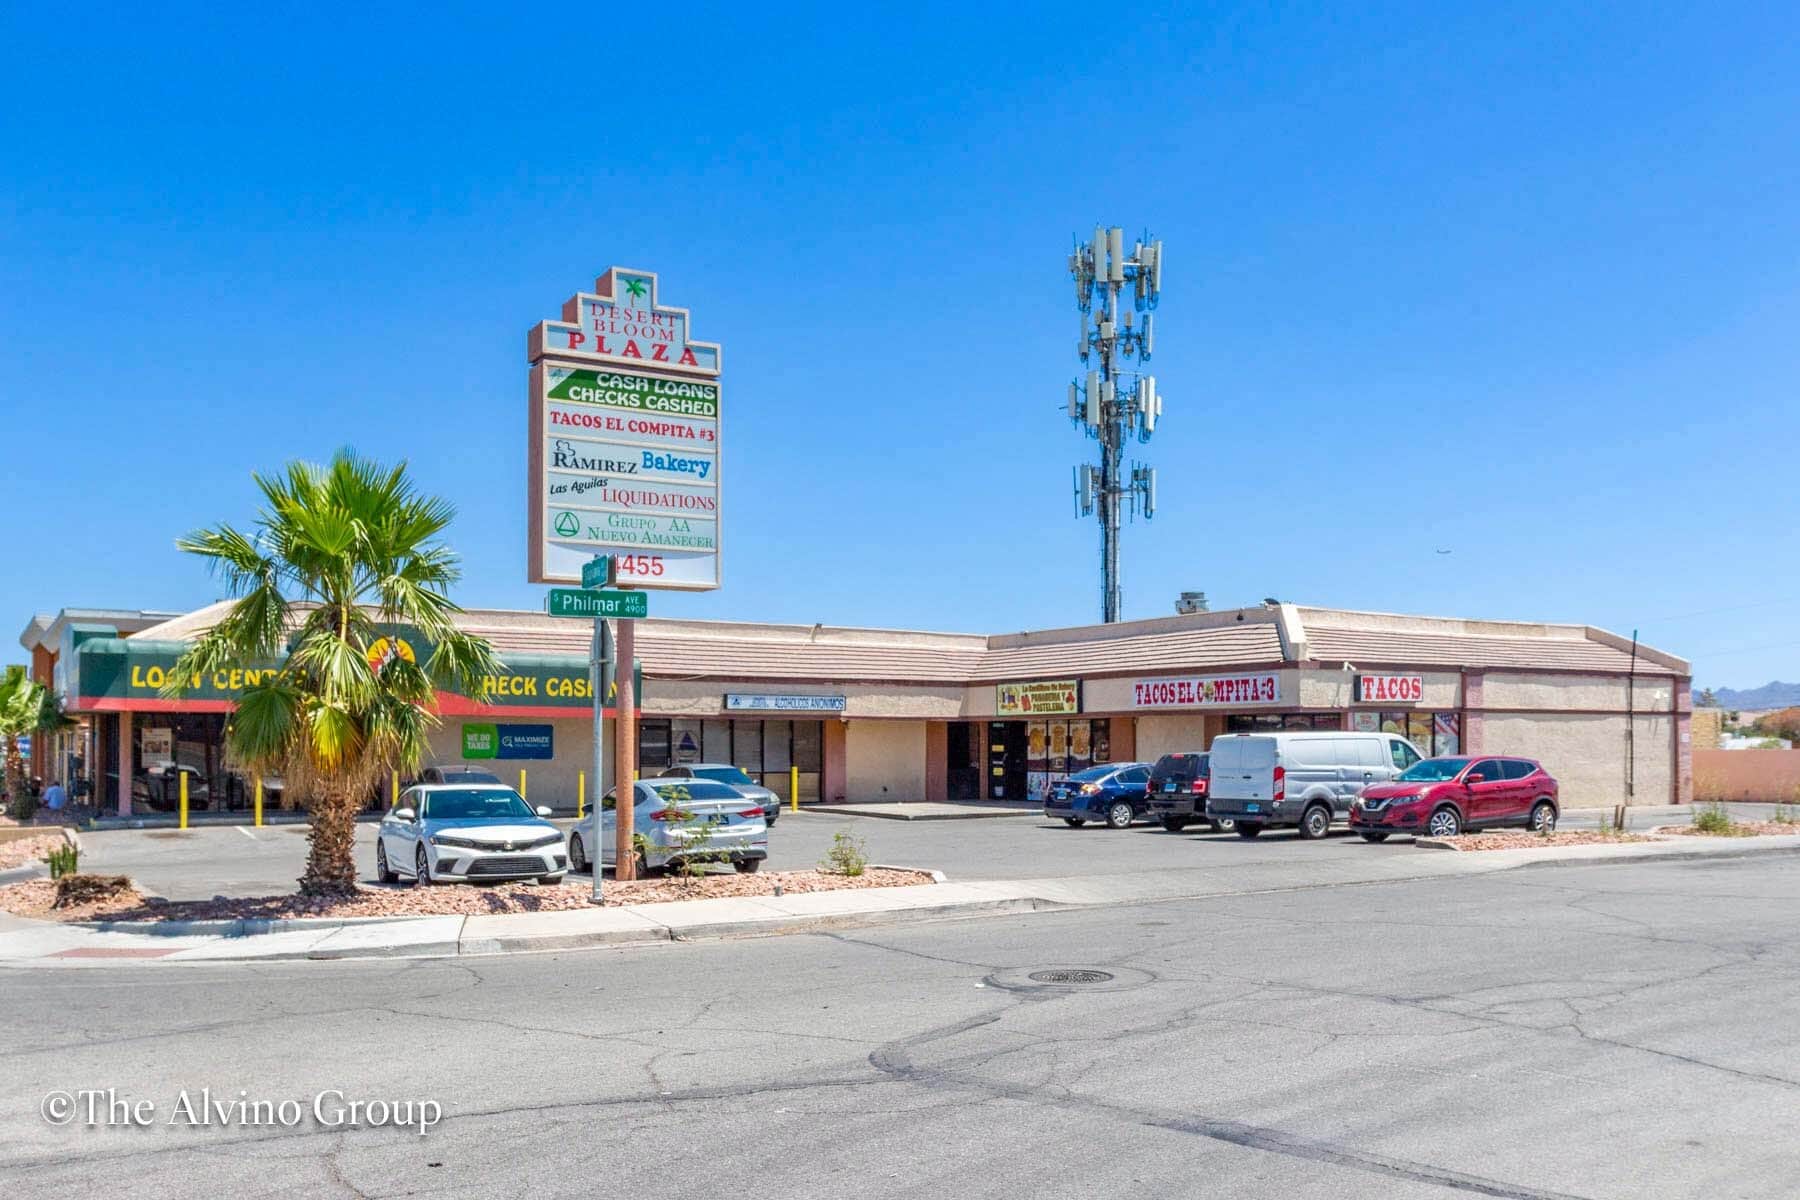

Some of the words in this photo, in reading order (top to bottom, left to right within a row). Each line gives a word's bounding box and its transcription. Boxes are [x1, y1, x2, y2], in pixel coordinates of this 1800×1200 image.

[591, 302, 678, 327] DESERT
[593, 318, 675, 342] BLOOM
[567, 331, 699, 367] PLAZA
[596, 373, 649, 391] CASH
[654, 380, 716, 400] LOANS
[568, 386, 641, 407] CHECKS
[645, 395, 715, 416] CASHED
[550, 411, 601, 429] TACOS
[606, 418, 625, 431] EL
[628, 420, 696, 439] COMPITA
[700, 429, 715, 442] #3
[552, 451, 638, 475] RAMIREZ
[641, 450, 711, 478] Bakery
[550, 483, 568, 495] Las
[571, 476, 609, 494] Aguilas
[601, 488, 715, 511] LIQUIDATIONS
[668, 519, 690, 532] AA
[563, 595, 621, 613] Philmar
[625, 596, 640, 605] AVE
[625, 605, 646, 614] 4900
[482, 675, 537, 696] HECK
[1135, 682, 1176, 705] TACOS
[1178, 681, 1195, 704] EL
[1197, 677, 1260, 703] CMPITA
[1362, 676, 1421, 700] TACOS
[467, 741, 490, 750] TAXES
